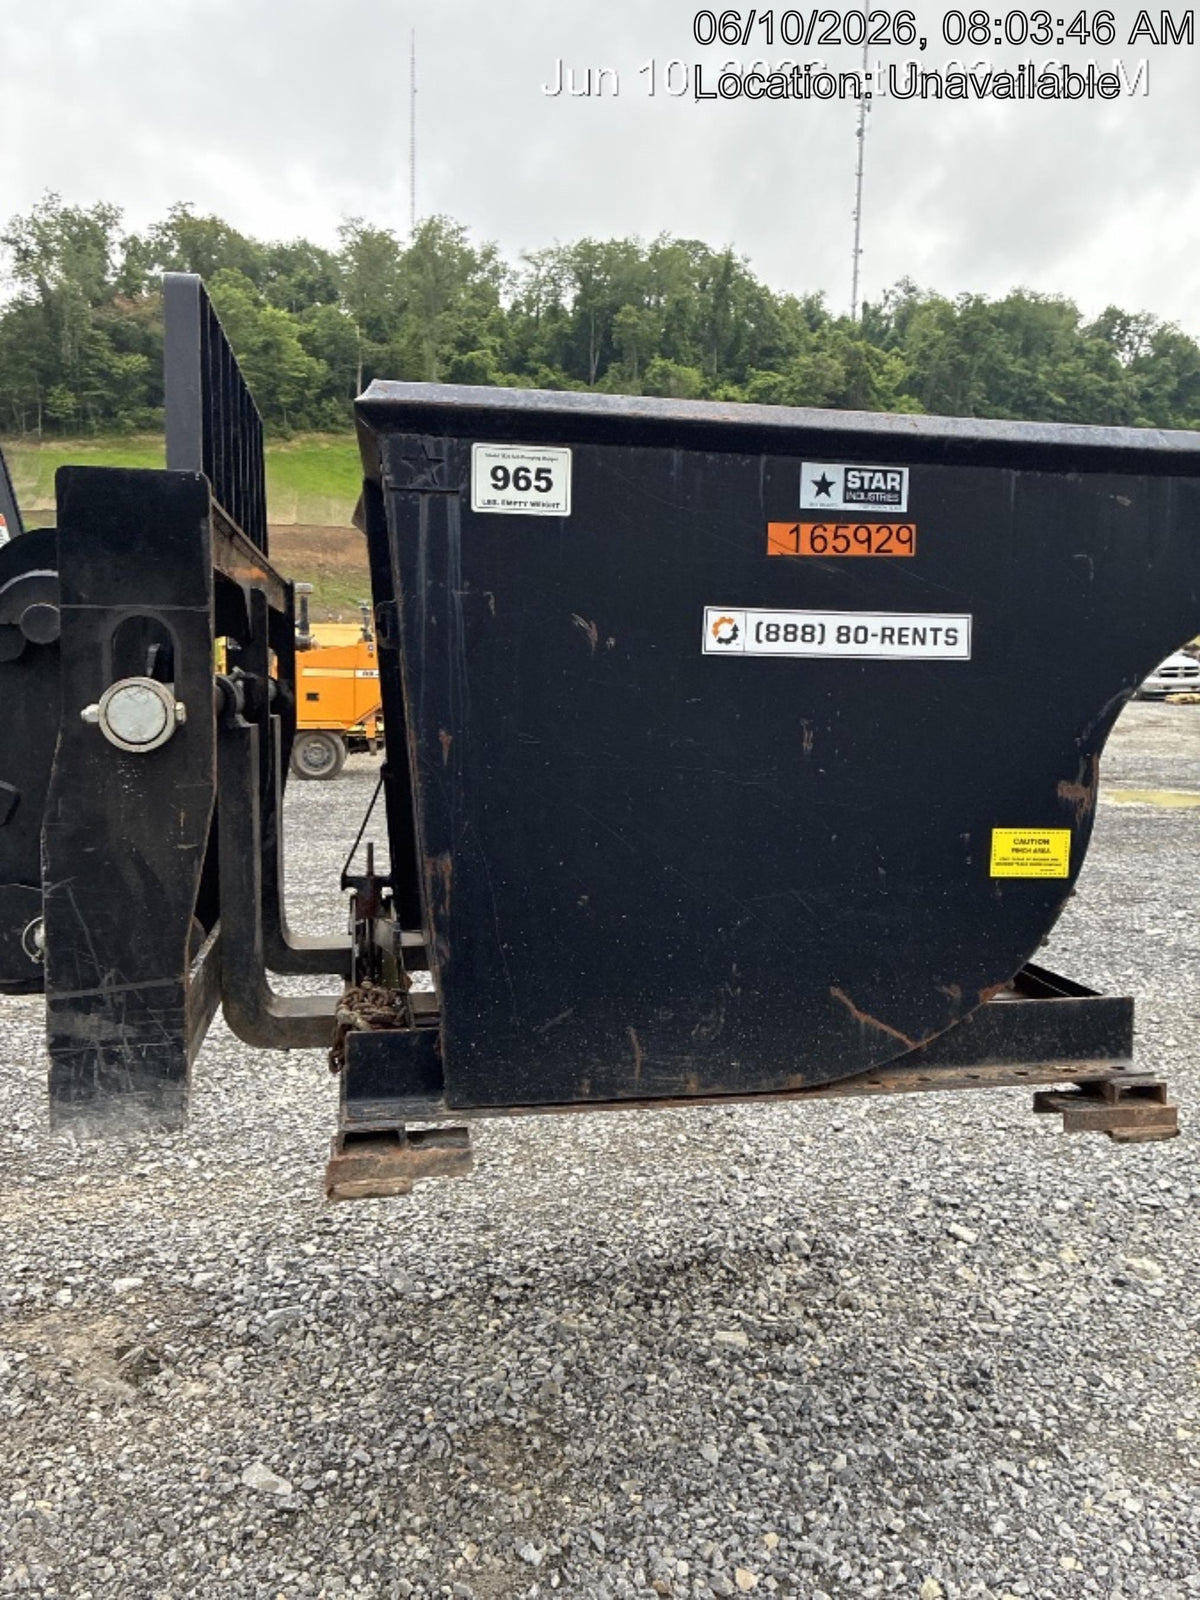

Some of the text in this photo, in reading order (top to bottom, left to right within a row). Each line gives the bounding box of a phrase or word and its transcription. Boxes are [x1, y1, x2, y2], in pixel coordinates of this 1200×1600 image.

[490, 465, 553, 493] 965
[847, 470, 900, 491] STAR
[501, 499, 529, 507] EMPTY
[530, 500, 561, 509] WEIGHT
[846, 491, 900, 502] INDUSTRIES
[789, 524, 913, 554] 165929
[755, 621, 959, 647] (888) 80-RENTS
